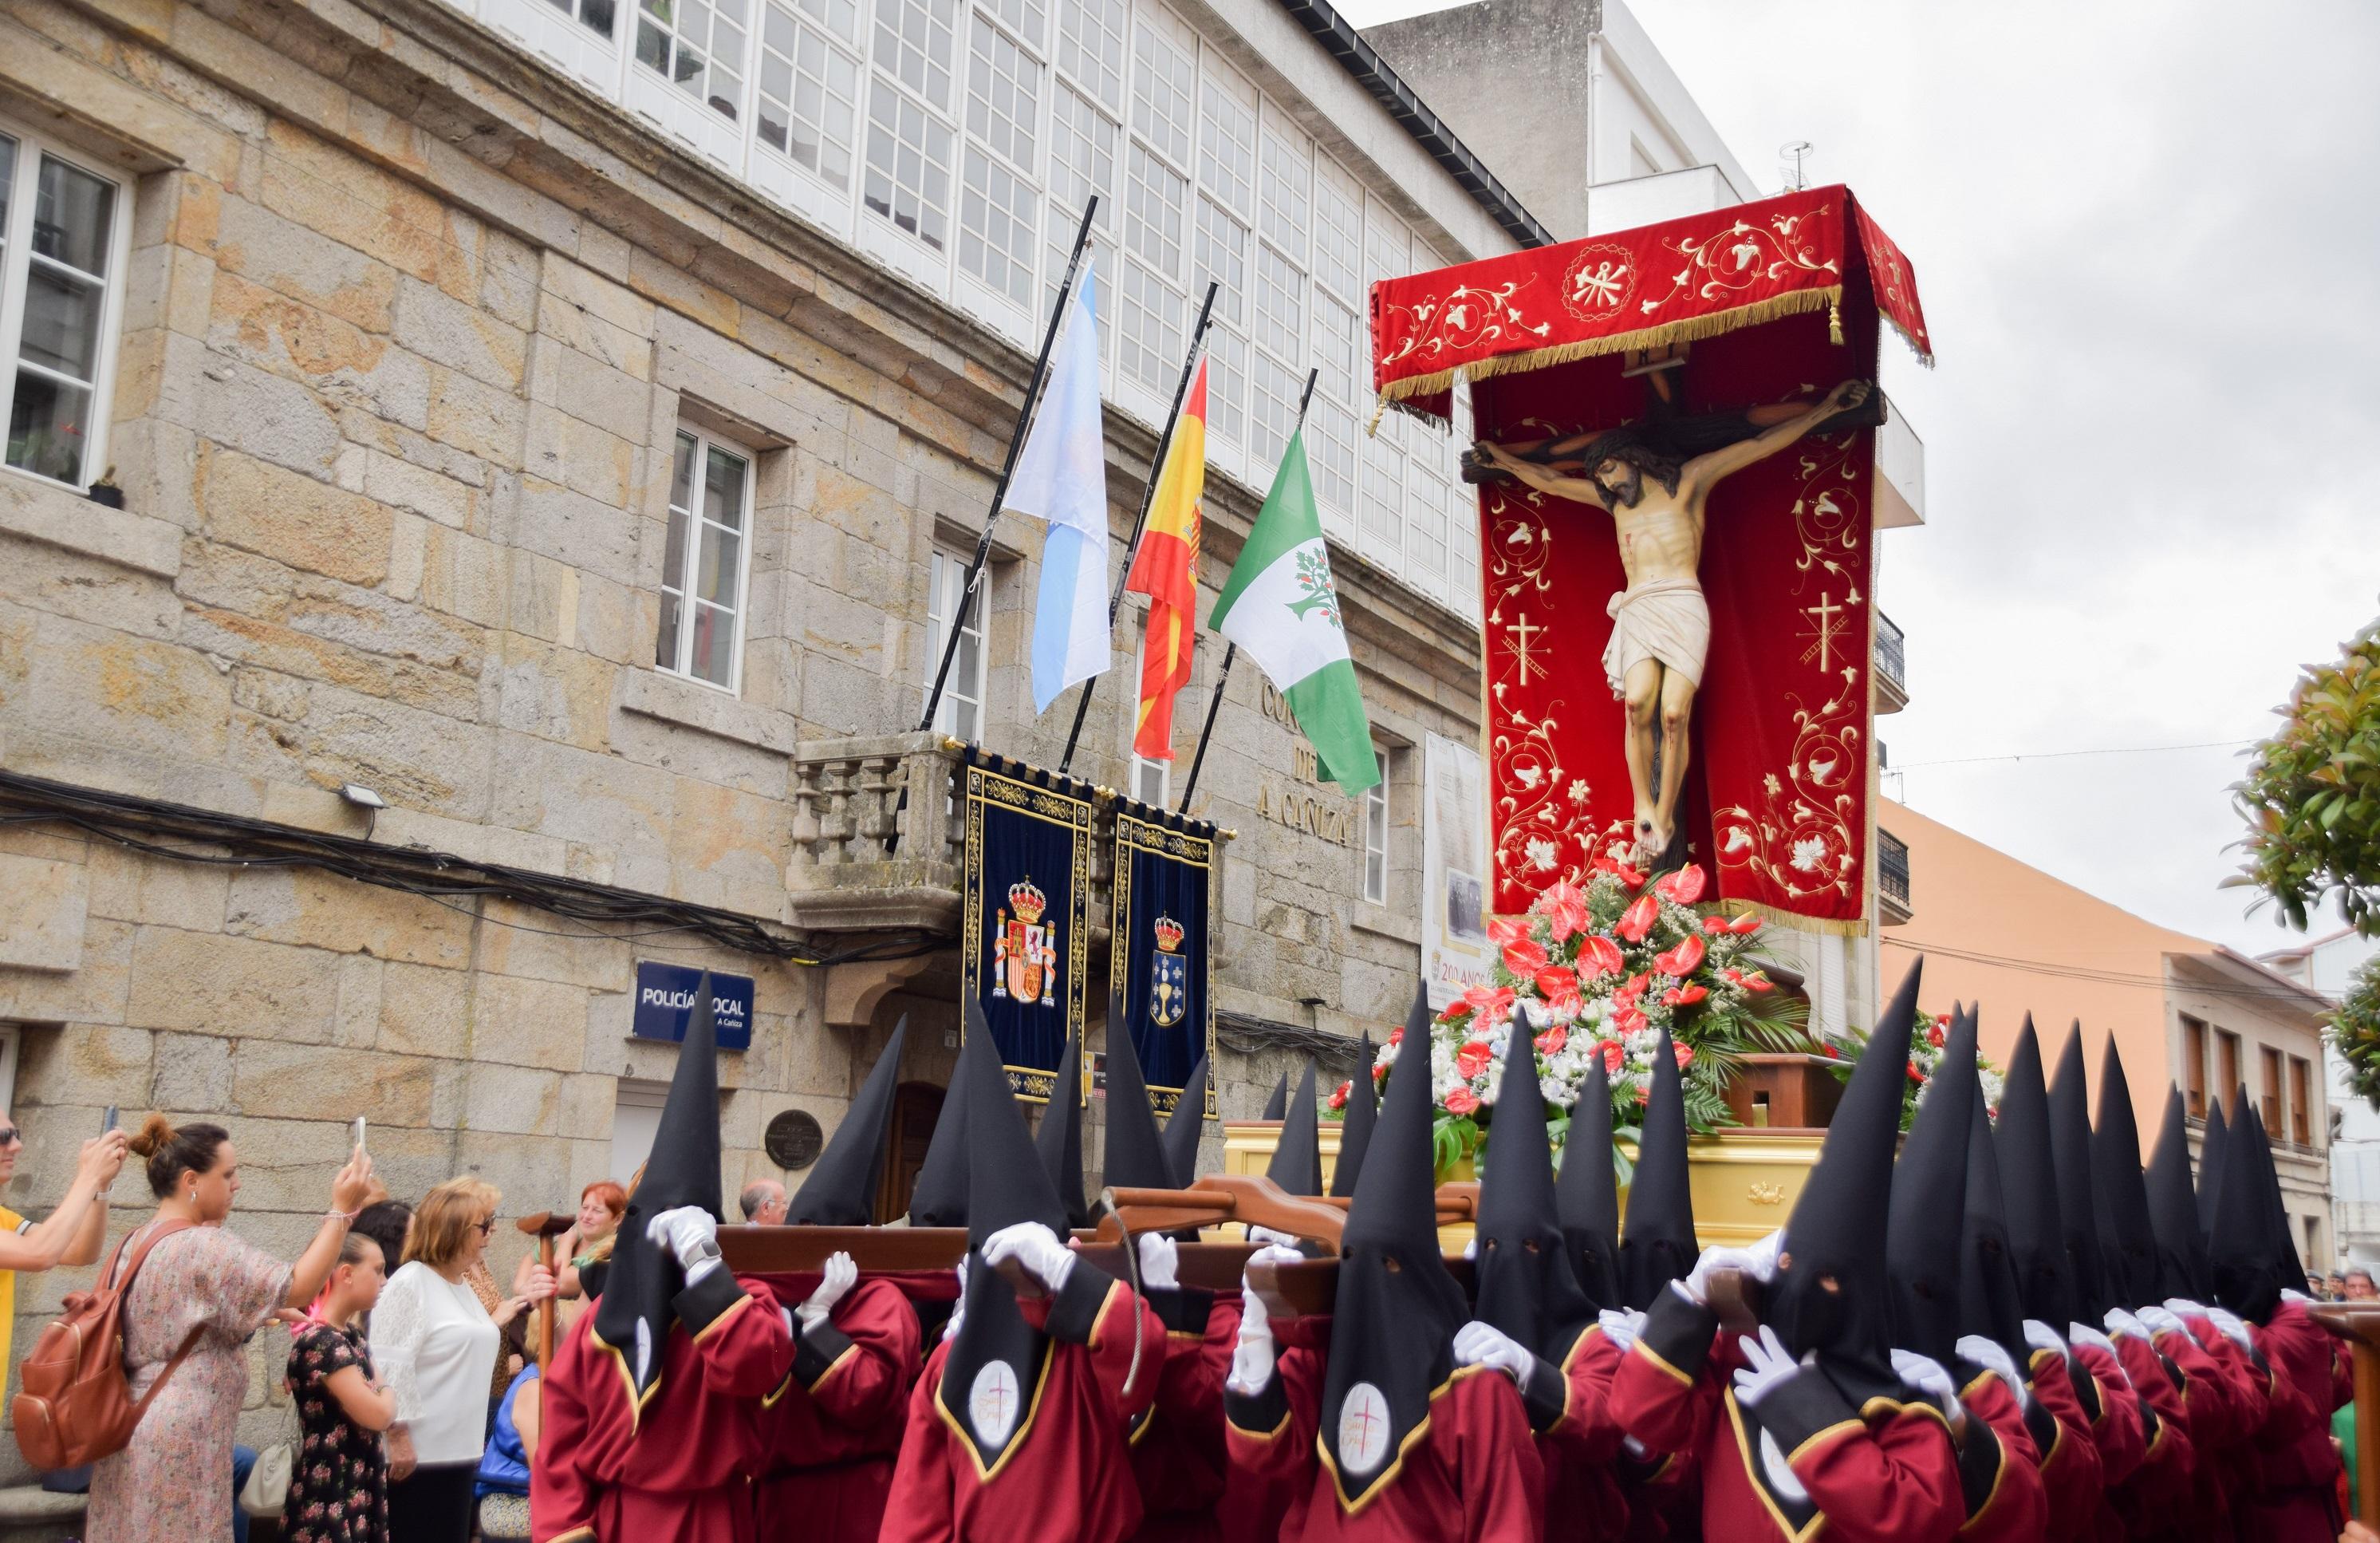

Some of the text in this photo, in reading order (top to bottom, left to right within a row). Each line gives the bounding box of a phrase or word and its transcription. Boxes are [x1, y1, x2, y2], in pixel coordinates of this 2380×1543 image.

[1294, 747, 1317, 781] DE
[1256, 784, 1269, 816] A
[1441, 962, 1458, 982] 200
[643, 988, 744, 1016] POLICÍA OCAL
[723, 1018, 743, 1028] Cañiza
